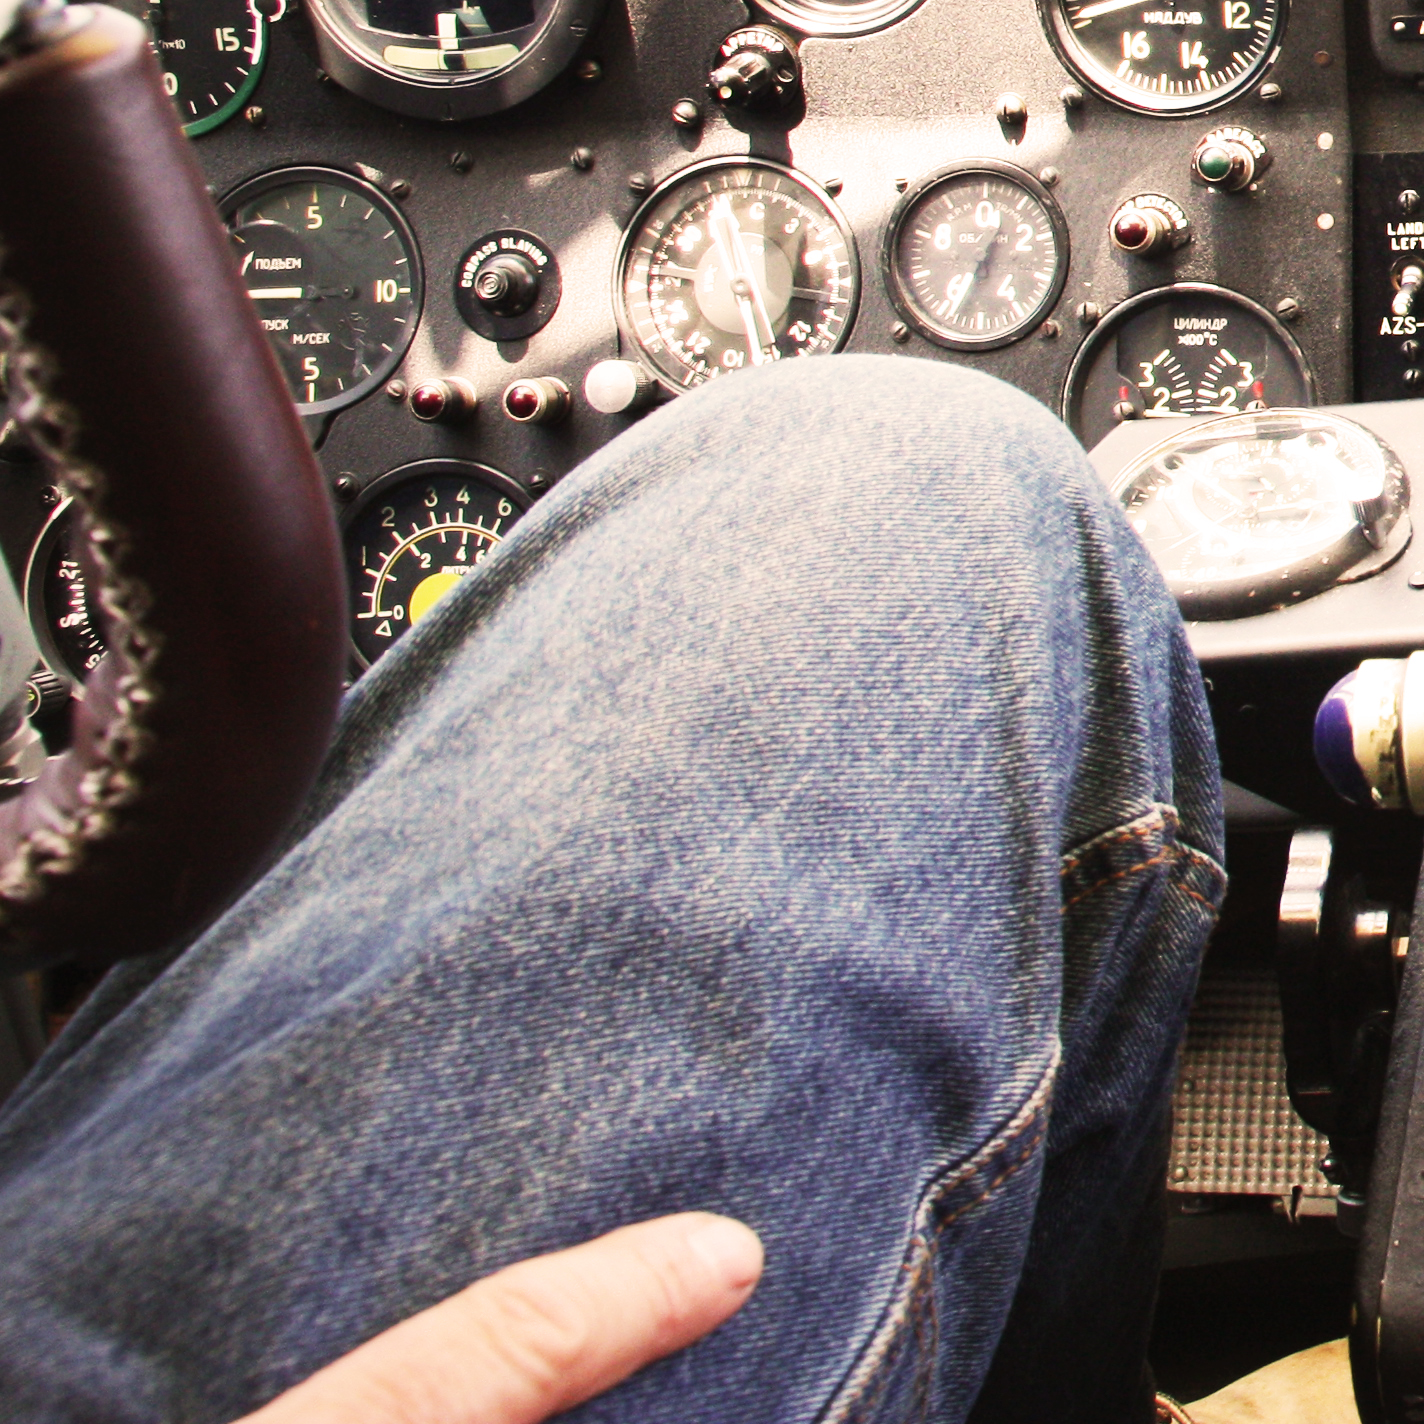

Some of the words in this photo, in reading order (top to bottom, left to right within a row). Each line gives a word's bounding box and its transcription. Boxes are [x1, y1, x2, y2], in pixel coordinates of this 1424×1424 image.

[1143, 12, 1203, 25] НАДДУВ
[1223, 0, 1251, 29] 12
[214, 27, 240, 51] 15
[1122, 31, 1150, 59] 16
[1180, 41, 1209, 69] 14
[255, 258, 302, 270] ПОДЪЕМ
[462, 240, 498, 288] COMPASS
[500, 237, 549, 267] SLAVING
[374, 279, 397, 303] 10
[1174, 318, 1228, 331] ЦИЛИНДР
[293, 332, 330, 345] М/СЕК
